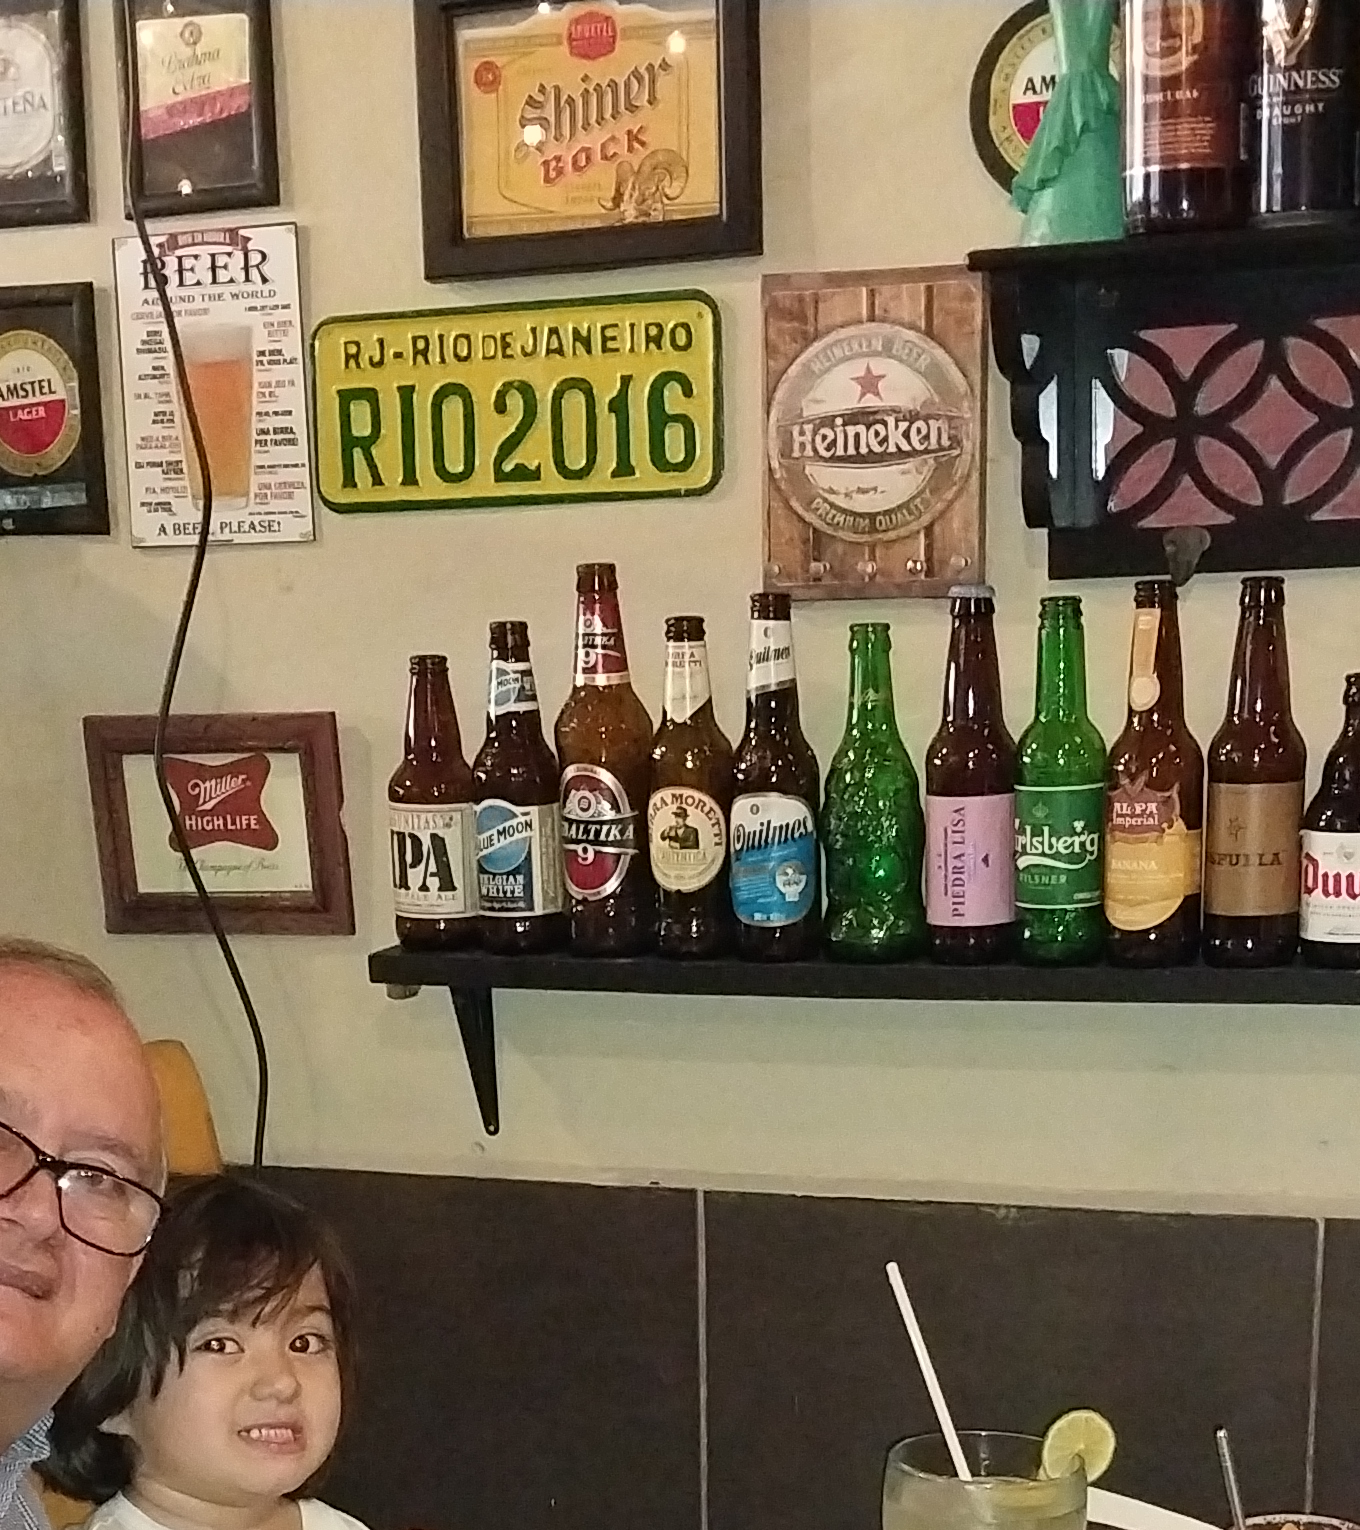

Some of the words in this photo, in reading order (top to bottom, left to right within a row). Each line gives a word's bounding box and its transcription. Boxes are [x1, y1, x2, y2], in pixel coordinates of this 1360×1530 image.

[1249, 69, 1341, 97] GUINNESS
[516, 57, 672, 145] Shiner
[541, 124, 648, 186] BOCK
[140, 249, 274, 291] BEER
[141, 294, 195, 307] ARUND
[200, 292, 224, 302] THE
[230, 289, 277, 300] WORLD
[520, 321, 695, 360] JANEIRO
[9, 406, 46, 422] LAGER
[791, 416, 952, 458] Heineken
[811, 498, 870, 532] PREMIUM
[876, 488, 932, 530] QUALITY
[157, 523, 168, 537] A
[173, 522, 214, 536] BEE,
[219, 520, 281, 534] PLEASE!
[187, 774, 250, 812] Miller
[185, 815, 224, 831] HIGH
[226, 814, 259, 829] LIFE
[479, 832, 496, 852] LUE
[497, 819, 533, 844] MOON
[562, 821, 634, 841] BALTIKA
[671, 793, 723, 848] MORETTI
[734, 815, 809, 850] Quilmes
[951, 805, 966, 846] LISA
[1112, 815, 1159, 828] Imperial
[577, 843, 595, 865] 9
[1015, 818, 1100, 861] rlsberg
[480, 885, 524, 897] WHITE
[951, 852, 966, 918] PIEDRA
[1019, 874, 1067, 885] PILSNER
